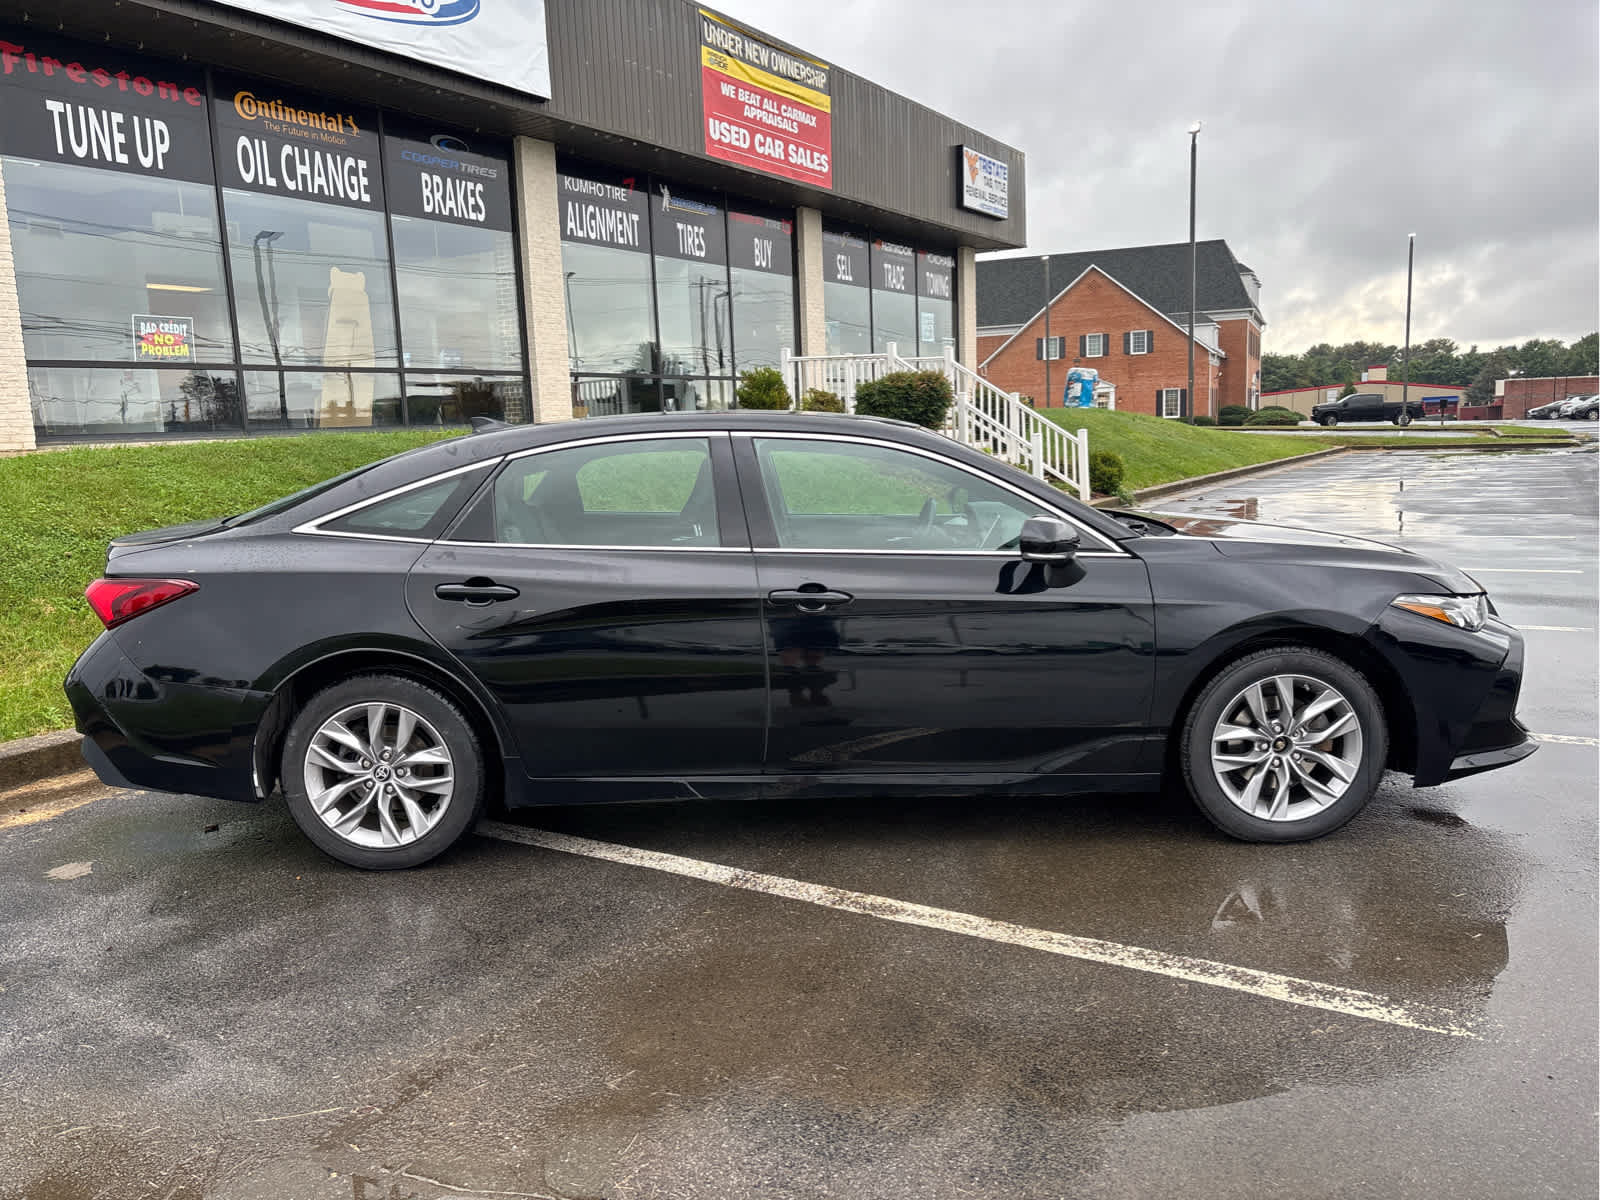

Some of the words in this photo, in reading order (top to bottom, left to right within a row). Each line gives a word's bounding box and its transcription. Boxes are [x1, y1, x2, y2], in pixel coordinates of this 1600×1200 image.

[703, 20, 742, 57] UNDER
[744, 39, 769, 68] NEW
[770, 52, 827, 89] OWNERSHIP
[0, 39, 201, 107] Firestone
[233, 91, 345, 134] Continental
[720, 82, 737, 99] WE
[738, 88, 761, 107] BEAT
[762, 98, 779, 114] ALL
[781, 104, 817, 128] CARMAX
[743, 105, 799, 134] APPRAISALS
[45, 99, 128, 164] TUNE
[133, 115, 170, 170] UP
[263, 120, 281, 132] The
[282, 124, 309, 138] Future
[311, 131, 319, 140] in
[320, 133, 347, 145] Motion
[708, 118, 751, 149] USED
[754, 133, 785, 160] CAR
[788, 143, 829, 173] SALES
[236, 135, 277, 187] OIL
[281, 144, 371, 203] CHANGE
[401, 149, 459, 170] COOPER
[460, 161, 497, 178] TIRES
[421, 172, 486, 222] BRAKES
[564, 176, 604, 197] KUMHO
[605, 185, 627, 201] TIRE
[567, 201, 639, 247] ALIGNMENT
[676, 222, 706, 257] TIRES
[753, 237, 772, 269] BUY
[836, 254, 853, 281] SELL
[883, 263, 905, 290] TRADE
[926, 271, 949, 297] TOWING
[140, 322, 157, 336] BAD
[159, 323, 187, 337] CREDIT
[153, 333, 175, 345] NO
[141, 342, 189, 357] PROBLEM
